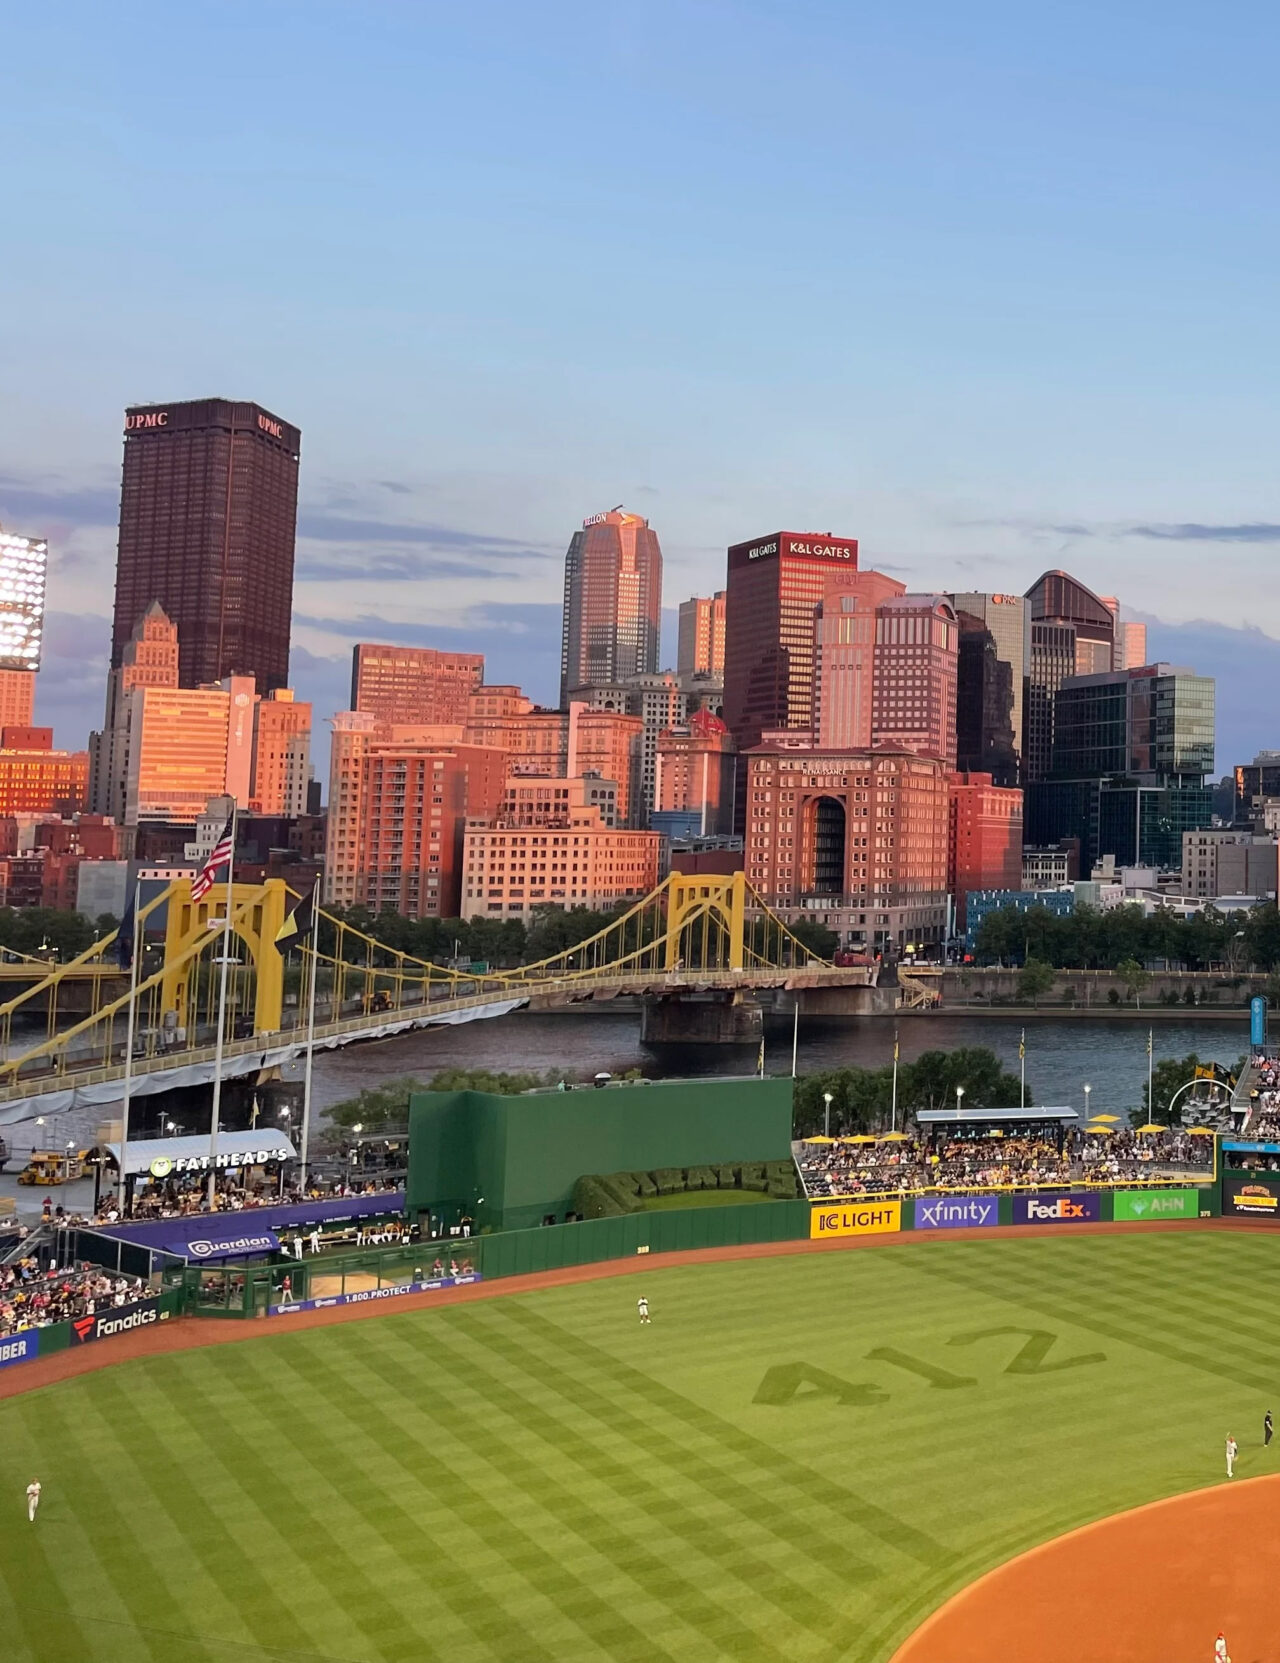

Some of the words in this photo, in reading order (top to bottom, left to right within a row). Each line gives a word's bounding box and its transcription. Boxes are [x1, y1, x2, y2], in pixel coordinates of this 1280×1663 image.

[126, 412, 168, 430] UPMC
[257, 414, 283, 439] UPMC
[749, 547, 759, 559] K&L
[758, 542, 777, 557] GATES
[790, 542, 811, 555] K&L
[813, 545, 850, 559] GATES
[803, 768, 847, 776] RENAISSANCE
[176, 1156, 210, 1172] FAT
[216, 1148, 288, 1168] HEAD'S
[921, 1201, 992, 1226] xfinity
[1028, 1199, 1085, 1219] FedEx
[1150, 1197, 1184, 1212] AHN
[819, 1213, 838, 1230] IC
[843, 1210, 893, 1227] LIGHT
[188, 1236, 270, 1257] Guardian
[228, 1243, 273, 1254] PROTECTION
[345, 1285, 411, 1304] 1.800.PROTECT
[97, 1309, 157, 1338] Fanatics
